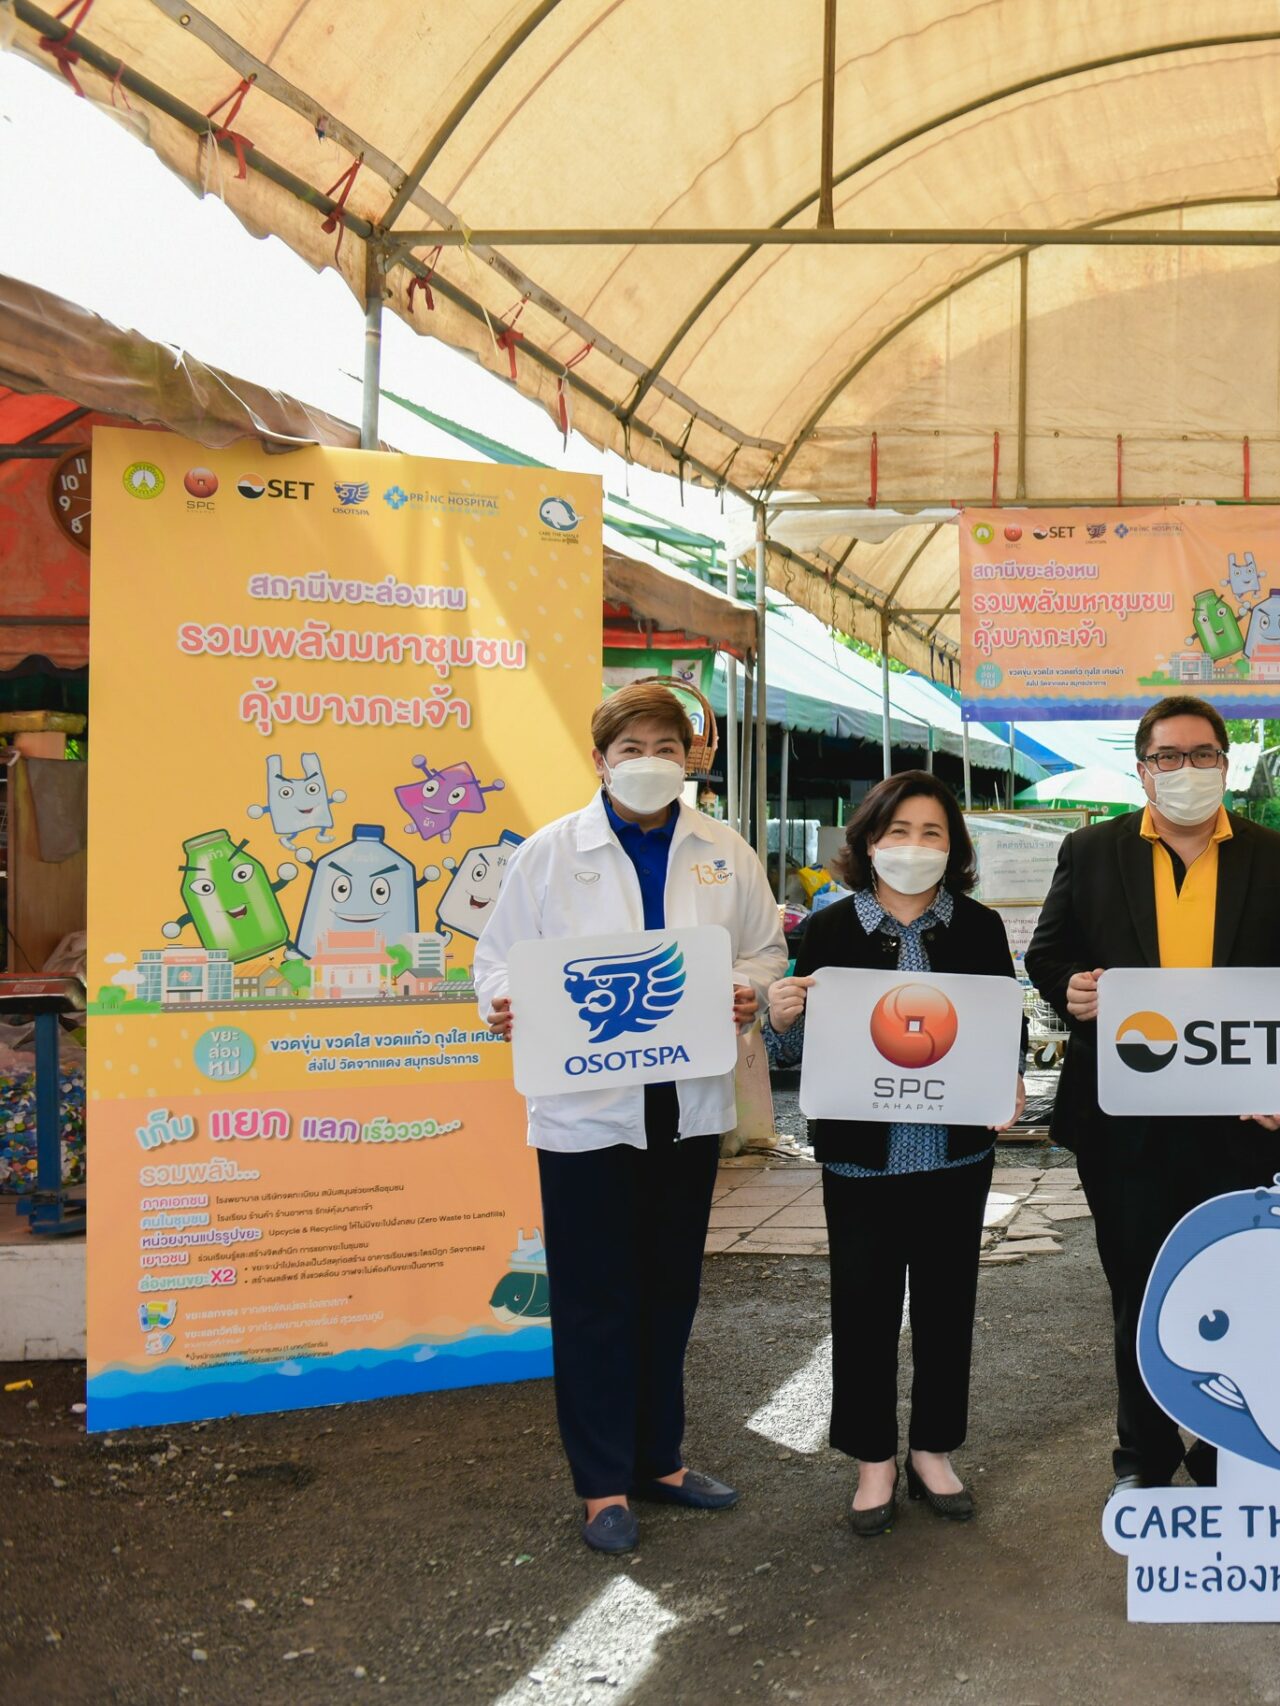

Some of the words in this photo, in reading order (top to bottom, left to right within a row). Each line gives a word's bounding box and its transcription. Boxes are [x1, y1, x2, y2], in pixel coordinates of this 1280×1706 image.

[75, 458, 87, 475] 11
[61, 474, 79, 490] 10
[268, 479, 315, 500] SET
[59, 495, 70, 511] 9
[186, 500, 215, 511] SPC
[448, 496, 498, 509] HOSPITAL
[71, 519, 82, 534] 8
[1049, 526, 1075, 539] SET
[973, 561, 1098, 578] สถานีขยะล่องหน
[249, 572, 465, 608] สถานีขยะล่องหน
[973, 590, 1173, 620] รวมพลังมหาชุมชน
[974, 620, 1105, 655] คุ้งบางกะเจ้า
[179, 620, 524, 674] รวมพลังมหาชุมชน
[242, 680, 470, 733] คุ้งบางกะเจ้า
[211, 1031, 239, 1042] ขยะ
[270, 1034, 320, 1053] ขวดขุ่น
[326, 1032, 370, 1049] ขวดใส
[375, 1030, 430, 1047] ขวดแก้ว
[435, 1029, 467, 1048] ถุงใส
[471, 1031, 504, 1042] เศษ
[308, 1057, 336, 1071] ส่งไป
[339, 1056, 401, 1070] วัดจากแดง
[404, 1053, 479, 1069] สมุทรปราการ
[565, 1044, 690, 1076] OSOTSPA
[874, 1077, 945, 1100] SPC
[872, 1102, 944, 1111] SAHAPAT
[137, 1109, 194, 1148] เก็บ
[211, 1110, 290, 1139] แยก
[303, 1119, 357, 1142] แลก
[142, 1228, 261, 1247] หน่วยงานแปรรูปขยะ
[142, 1254, 188, 1266] เยาวชน
[210, 1269, 235, 1284] X2
[1114, 1505, 1223, 1539] CARE
